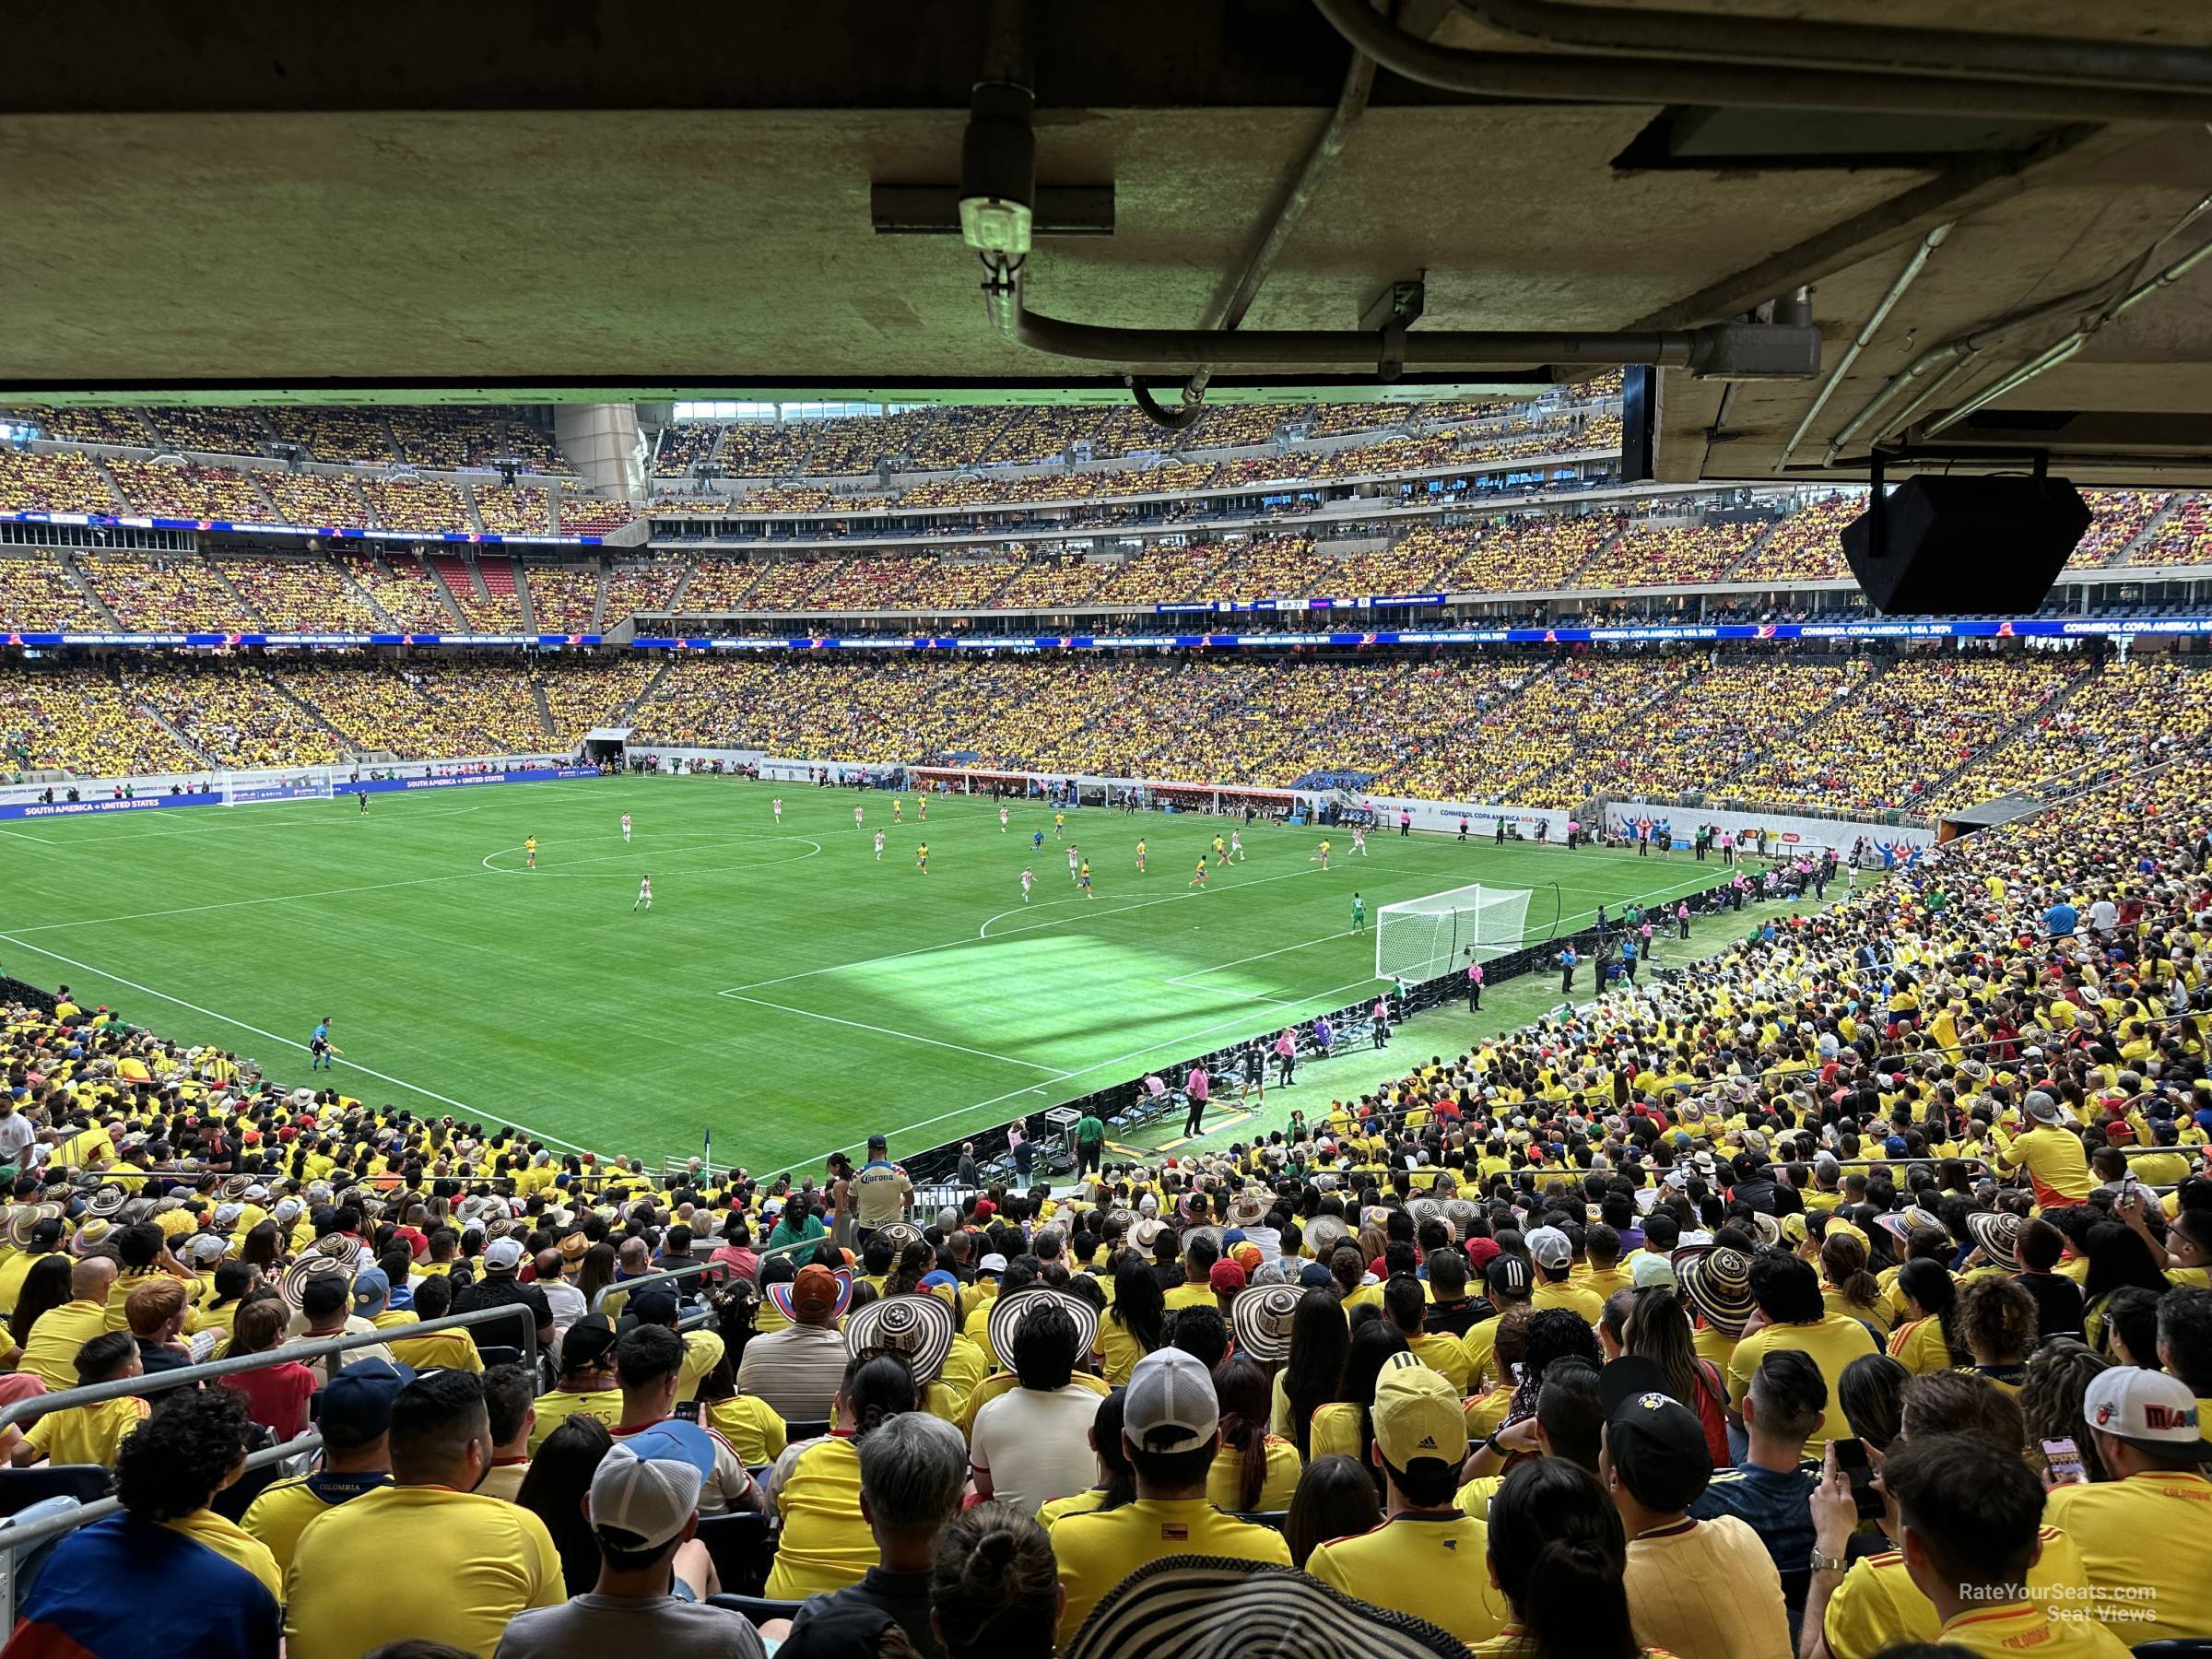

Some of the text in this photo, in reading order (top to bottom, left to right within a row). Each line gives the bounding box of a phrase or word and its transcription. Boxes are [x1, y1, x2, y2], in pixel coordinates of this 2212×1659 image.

[2064, 624, 2121, 632] CONMEBOL
[2122, 623, 2151, 631] COPA
[2152, 622, 2197, 631] AMERICA
[25, 807, 56, 815] SOUTH
[57, 804, 93, 814] AMERICA
[101, 802, 130, 810] UNITED
[131, 799, 159, 808] STATES
[1440, 810, 1473, 818] CONMEBOL
[861, 1174, 894, 1185] Corona
[2002, 1626, 2051, 1649] COLOMBIA
